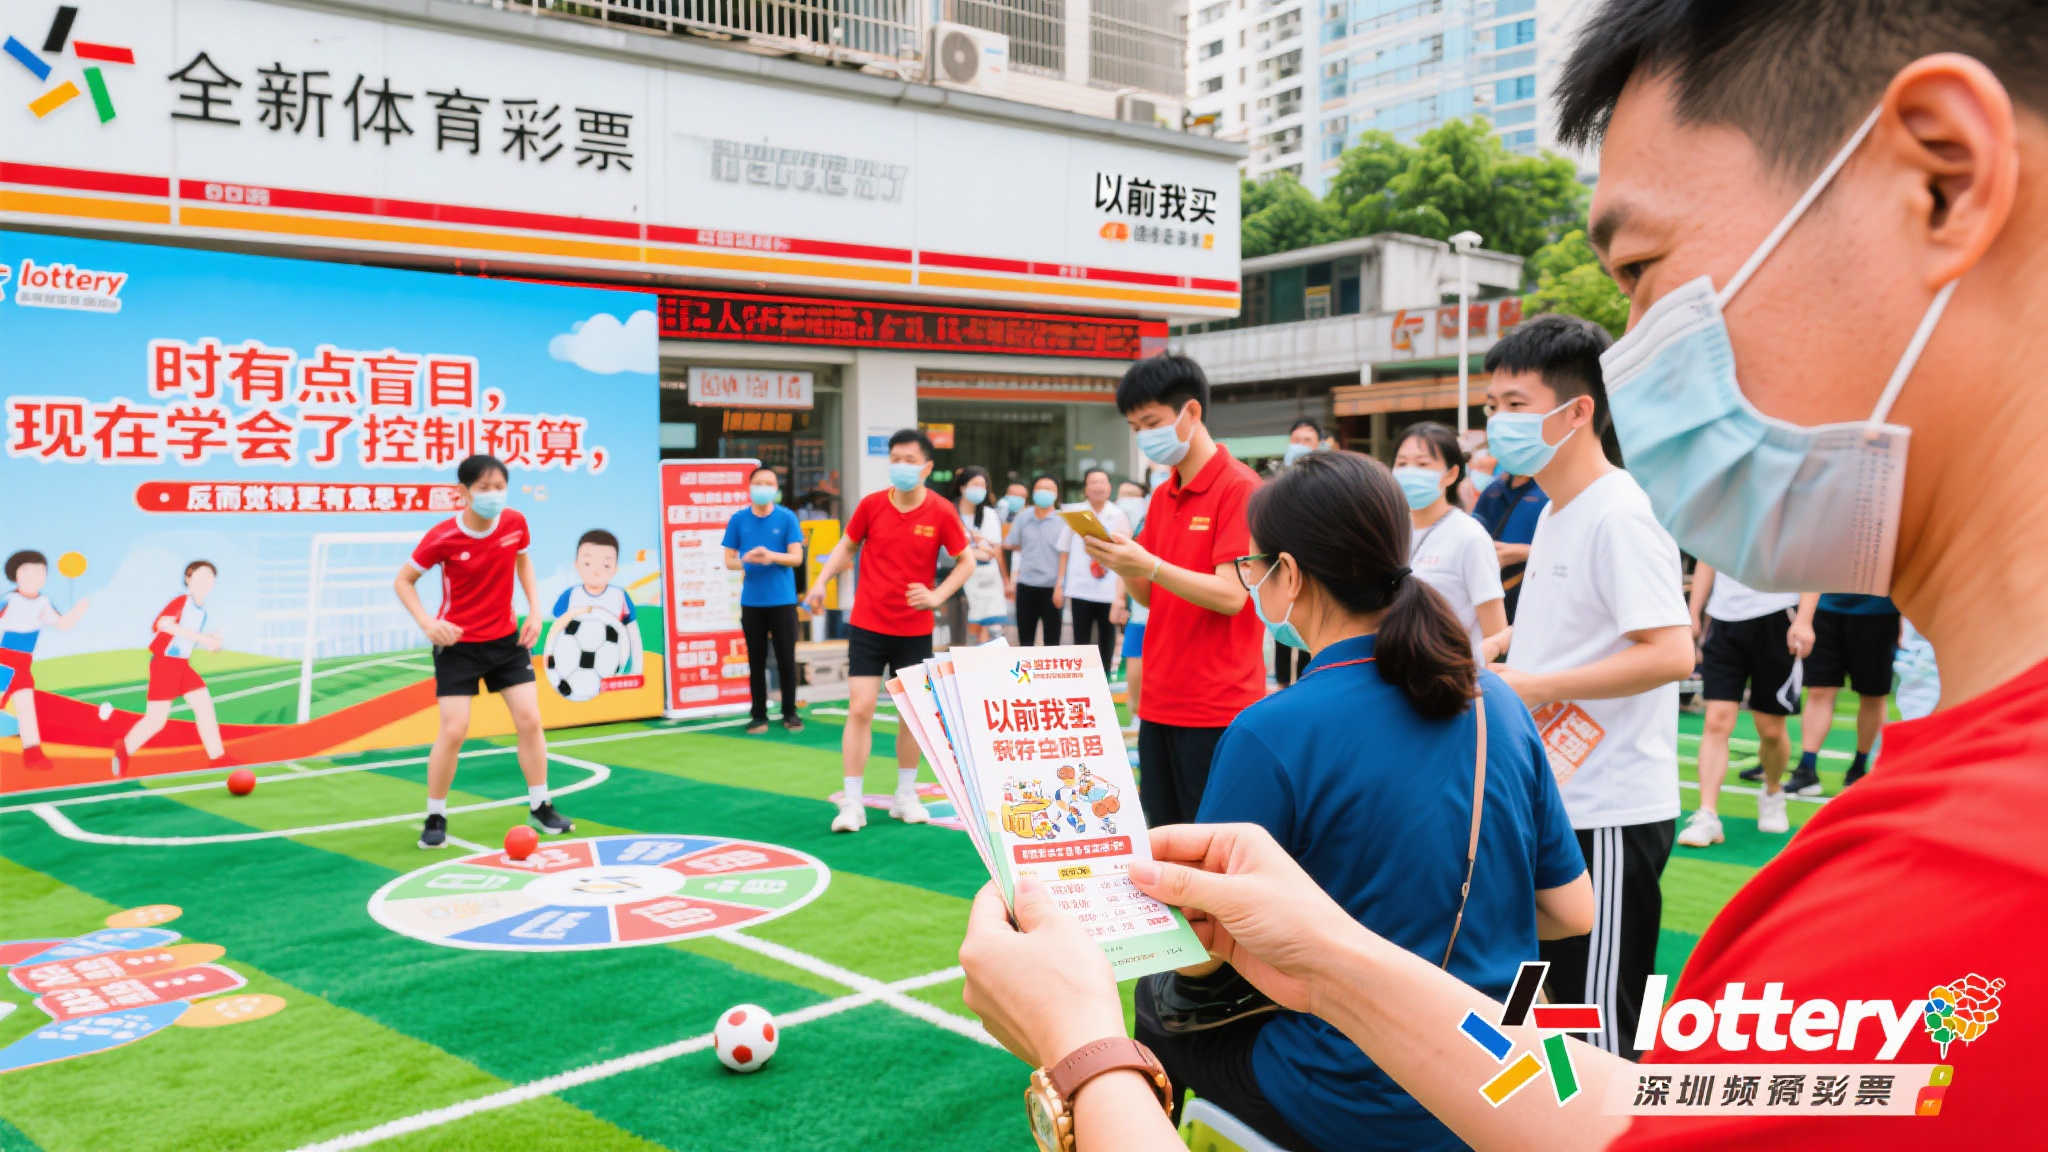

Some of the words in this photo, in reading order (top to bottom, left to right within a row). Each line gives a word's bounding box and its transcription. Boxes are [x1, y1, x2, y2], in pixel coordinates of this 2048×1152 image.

[167, 51, 636, 172] 全新体育彩票
[1095, 172, 1217, 225] 以前我买
[21, 261, 122, 296] lottery
[155, 343, 506, 413] 时有点盲目，
